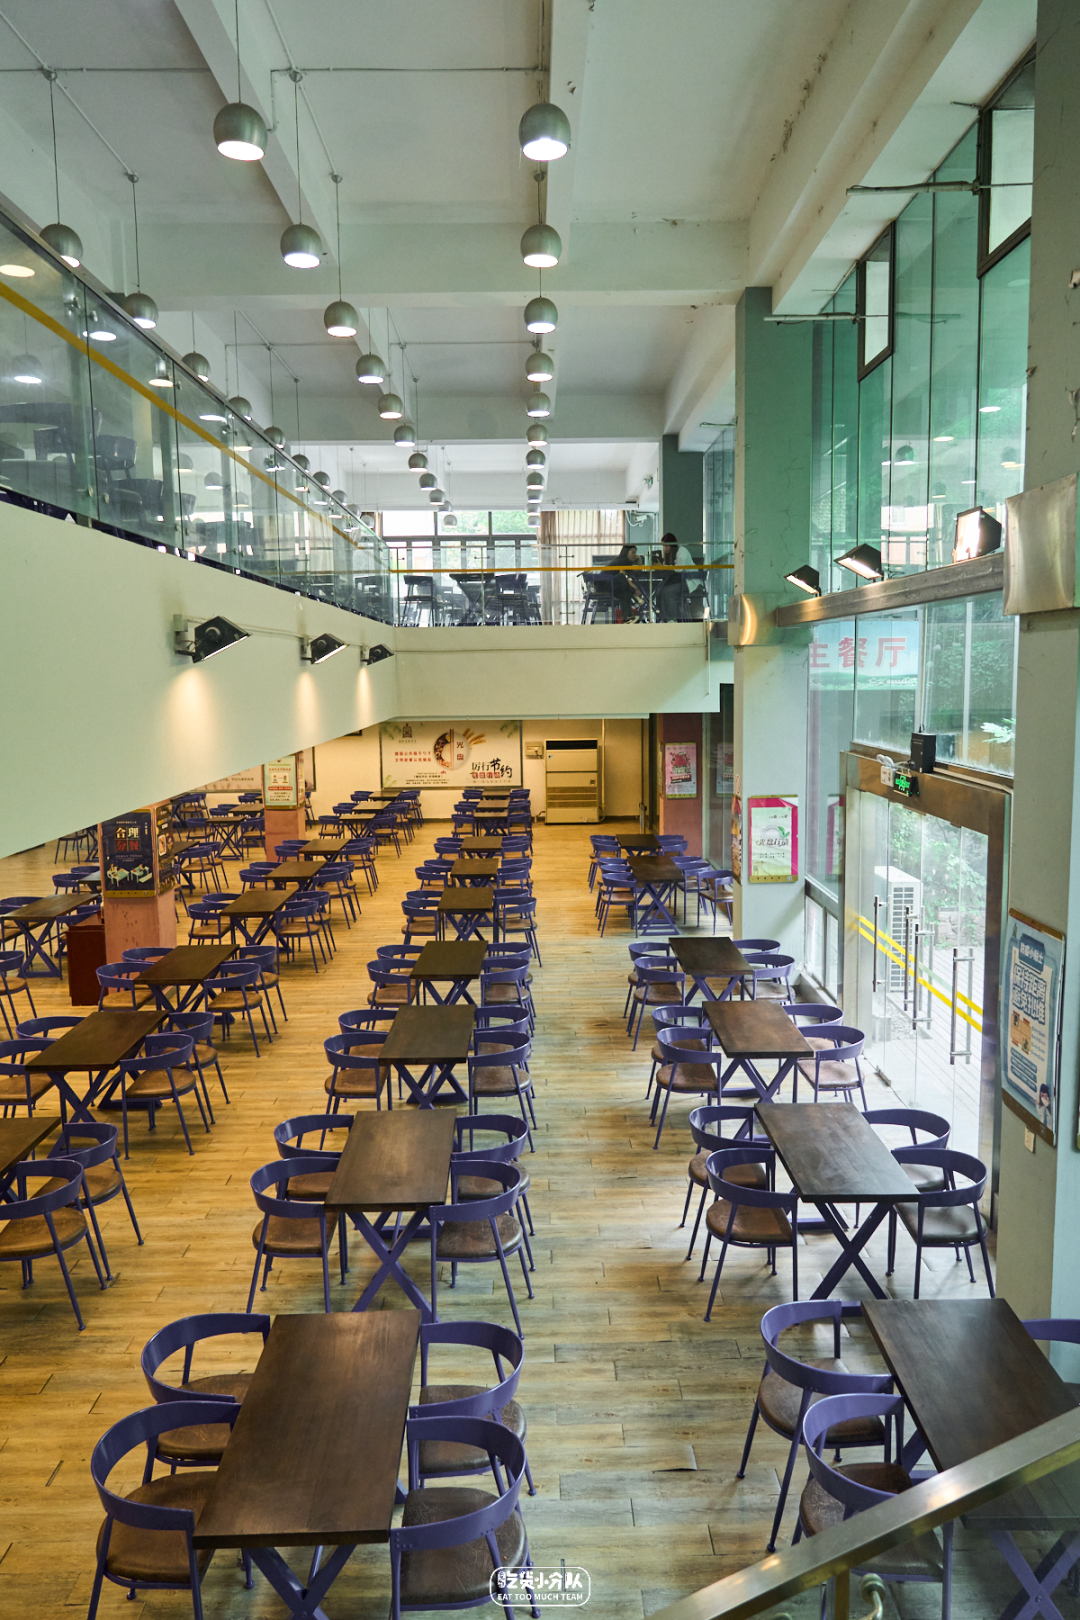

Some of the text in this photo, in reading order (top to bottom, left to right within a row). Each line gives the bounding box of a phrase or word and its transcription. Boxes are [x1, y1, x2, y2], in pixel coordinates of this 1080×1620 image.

[116, 827, 139, 839] 合理
[1013, 963, 1047, 1000] 保持距离
[1012, 984, 1046, 1025] 避免扎堆
